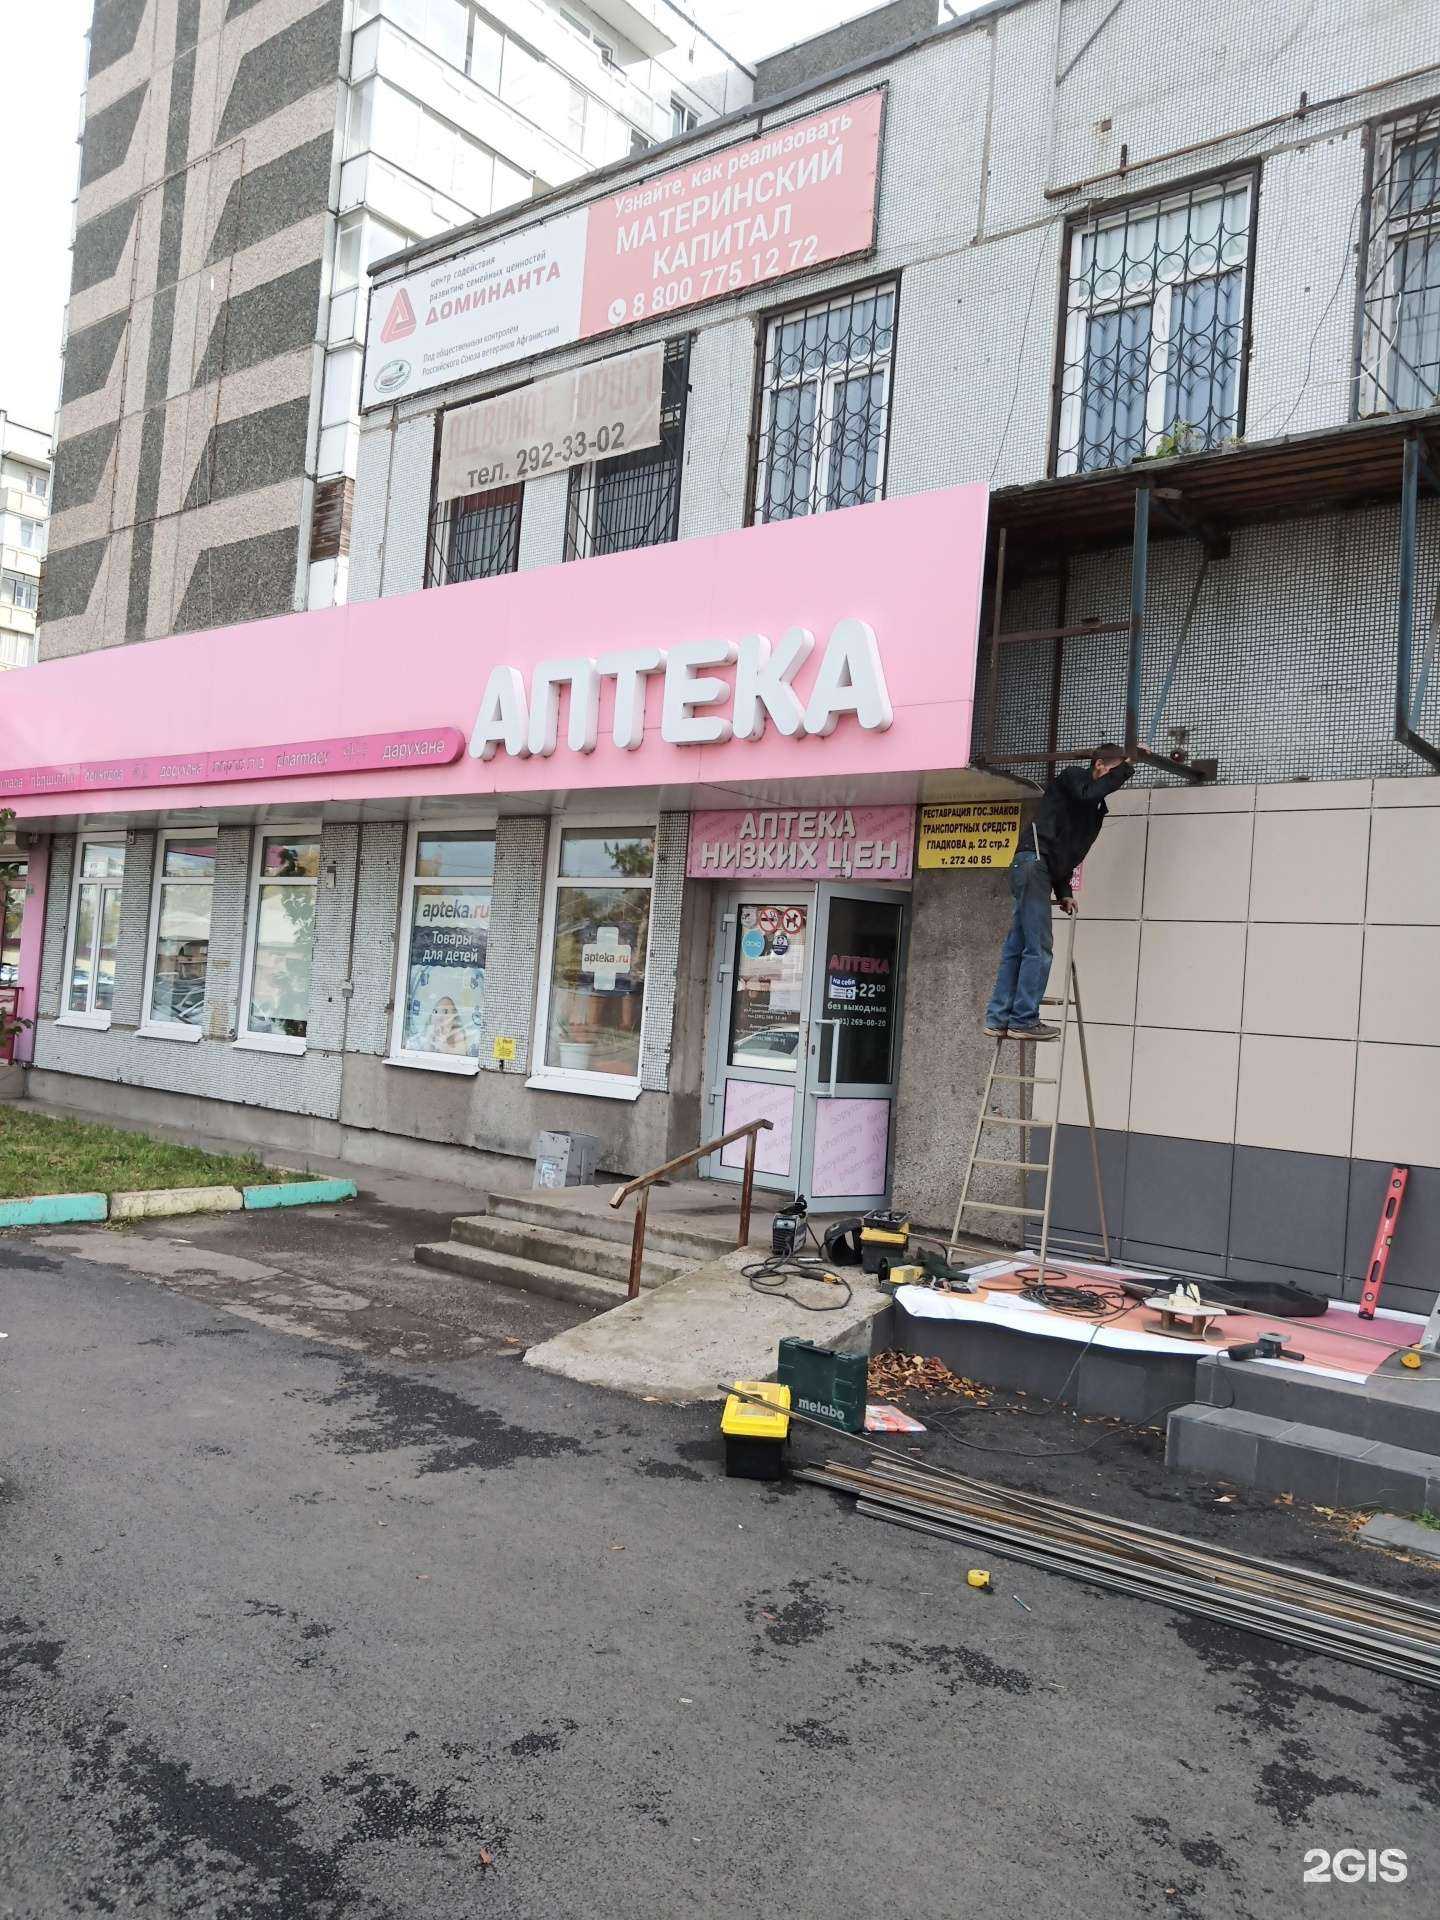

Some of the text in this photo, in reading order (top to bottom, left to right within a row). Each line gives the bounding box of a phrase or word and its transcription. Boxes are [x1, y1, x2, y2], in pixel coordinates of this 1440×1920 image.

[615, 114, 852, 217] Узнайте, как реализовать
[616, 137, 843, 255] МАТЕРИНСКИЙ
[652, 204, 792, 279] КАПИТАЛ
[430, 256, 495, 287] центр содействия
[466, 270, 503, 288] семейных
[506, 250, 546, 273] ценностей
[632, 235, 818, 317] 8 800 775 12 72
[425, 261, 561, 326] ДОМИНАНТА
[467, 422, 625, 488] тел. 292-33-02
[468, 617, 894, 761] АПТЕКА
[923, 807, 971, 818] РЕСТАВРАЦИЯ
[739, 810, 857, 840] АПТЕКА
[923, 821, 1017, 834] ТРАНСПОРТНЫХ СРЕДСТВ
[926, 838, 1010, 850] ГЛАДКОВА д. 22 стр.2
[701, 839, 899, 878] НИЗКИХ ЦЕН
[941, 855, 992, 865] т. 272 40 85
[422, 900, 490, 922] apteka.ru
[432, 931, 472, 947] Товары
[422, 947, 478, 963] для детей
[584, 951, 629, 965] apteka.ru
[829, 954, 890, 975] АПТЕКА
[841, 978, 856, 986] себя
[828, 1001, 887, 1014] без выходных
[798, 1398, 845, 1420] metabo
